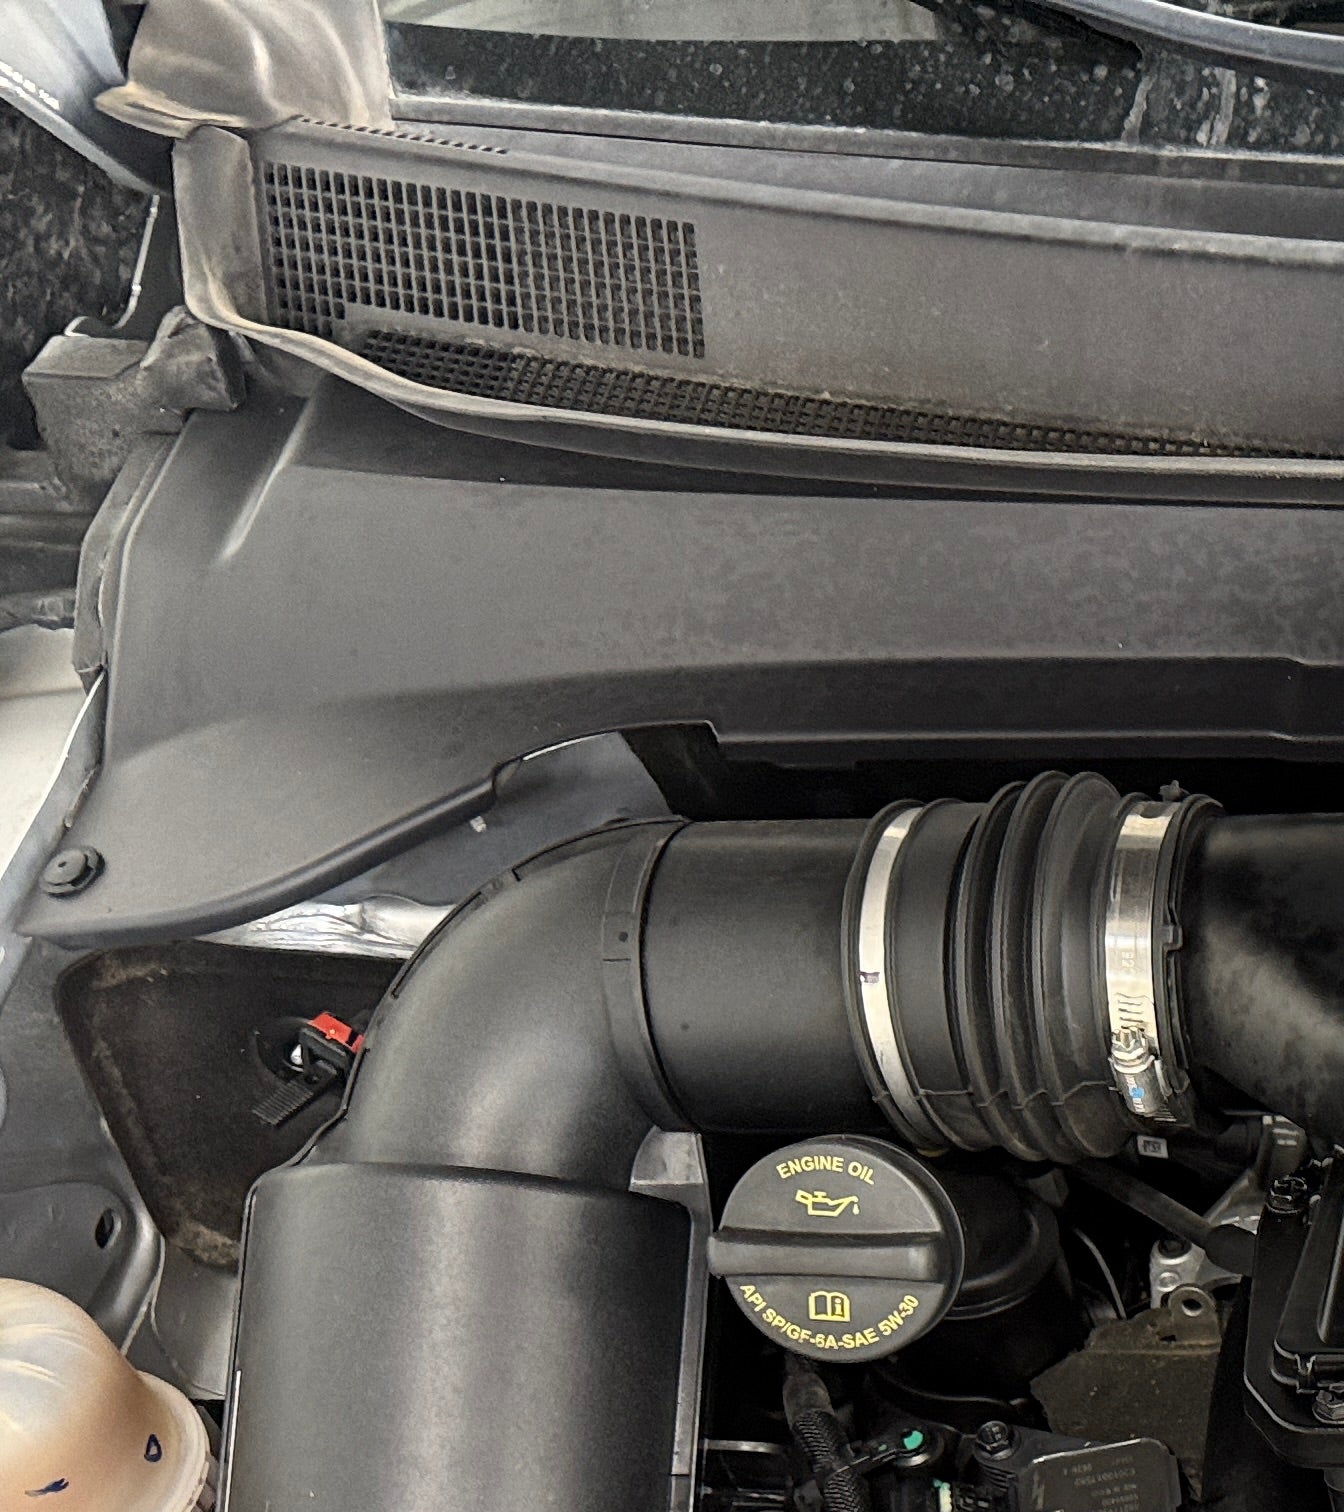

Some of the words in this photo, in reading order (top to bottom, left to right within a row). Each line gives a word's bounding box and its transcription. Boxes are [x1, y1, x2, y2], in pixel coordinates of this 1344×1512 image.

[776, 1155, 845, 1180] ENGINE
[848, 1162, 875, 1185] OIL
[740, 1283, 767, 1312] API
[878, 1294, 920, 1336] 5W-30
